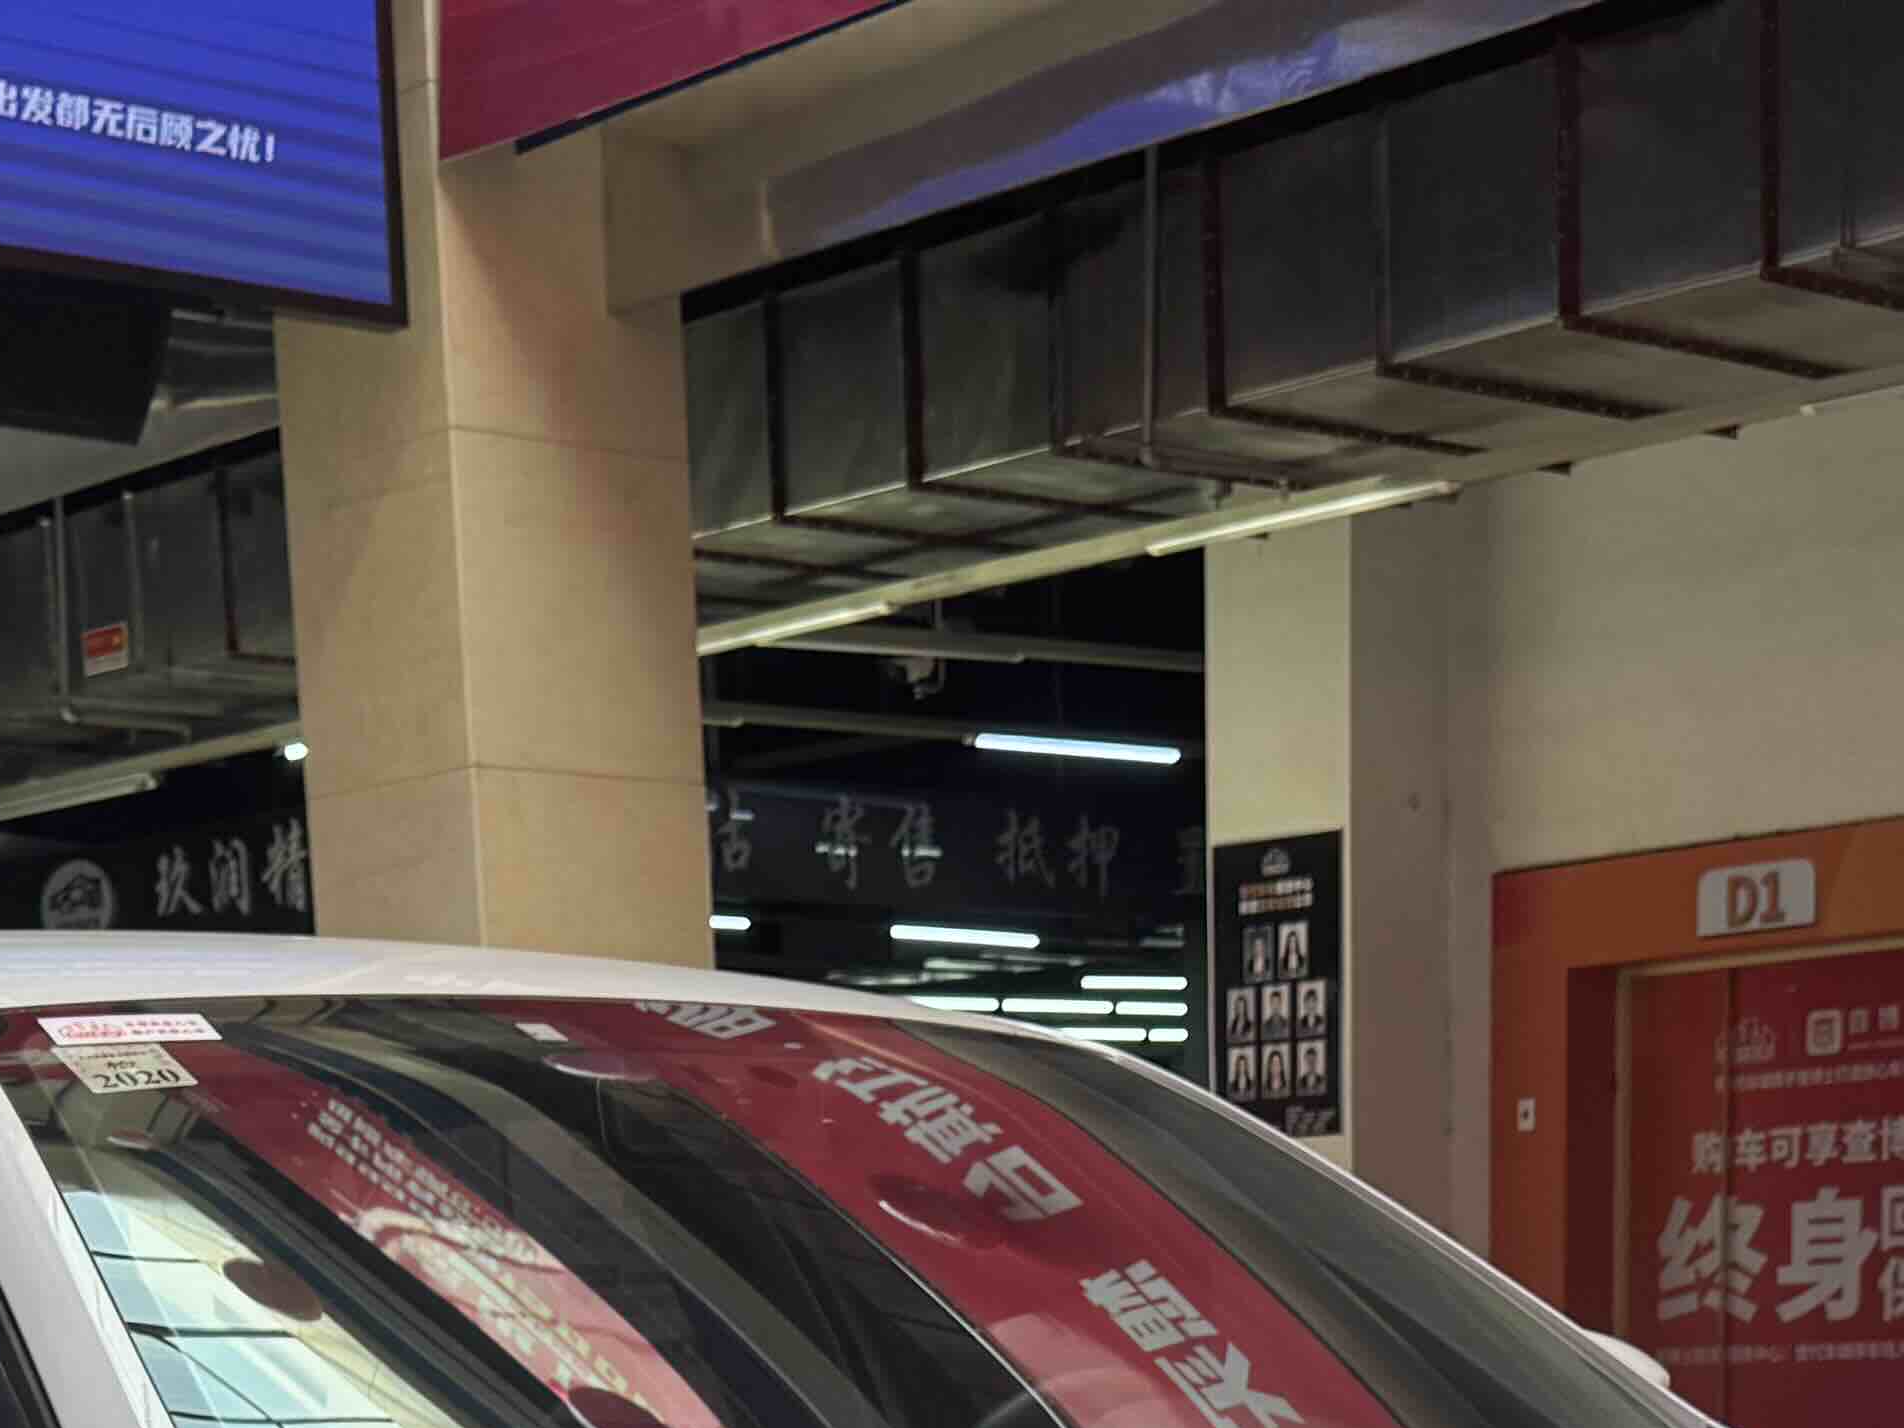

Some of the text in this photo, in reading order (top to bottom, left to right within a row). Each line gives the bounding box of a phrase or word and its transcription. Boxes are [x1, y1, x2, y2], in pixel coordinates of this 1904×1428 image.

[1725, 869, 1787, 929] D1
[95, 1069, 181, 1089] 2020
[1656, 1185, 1882, 1323] 终身
